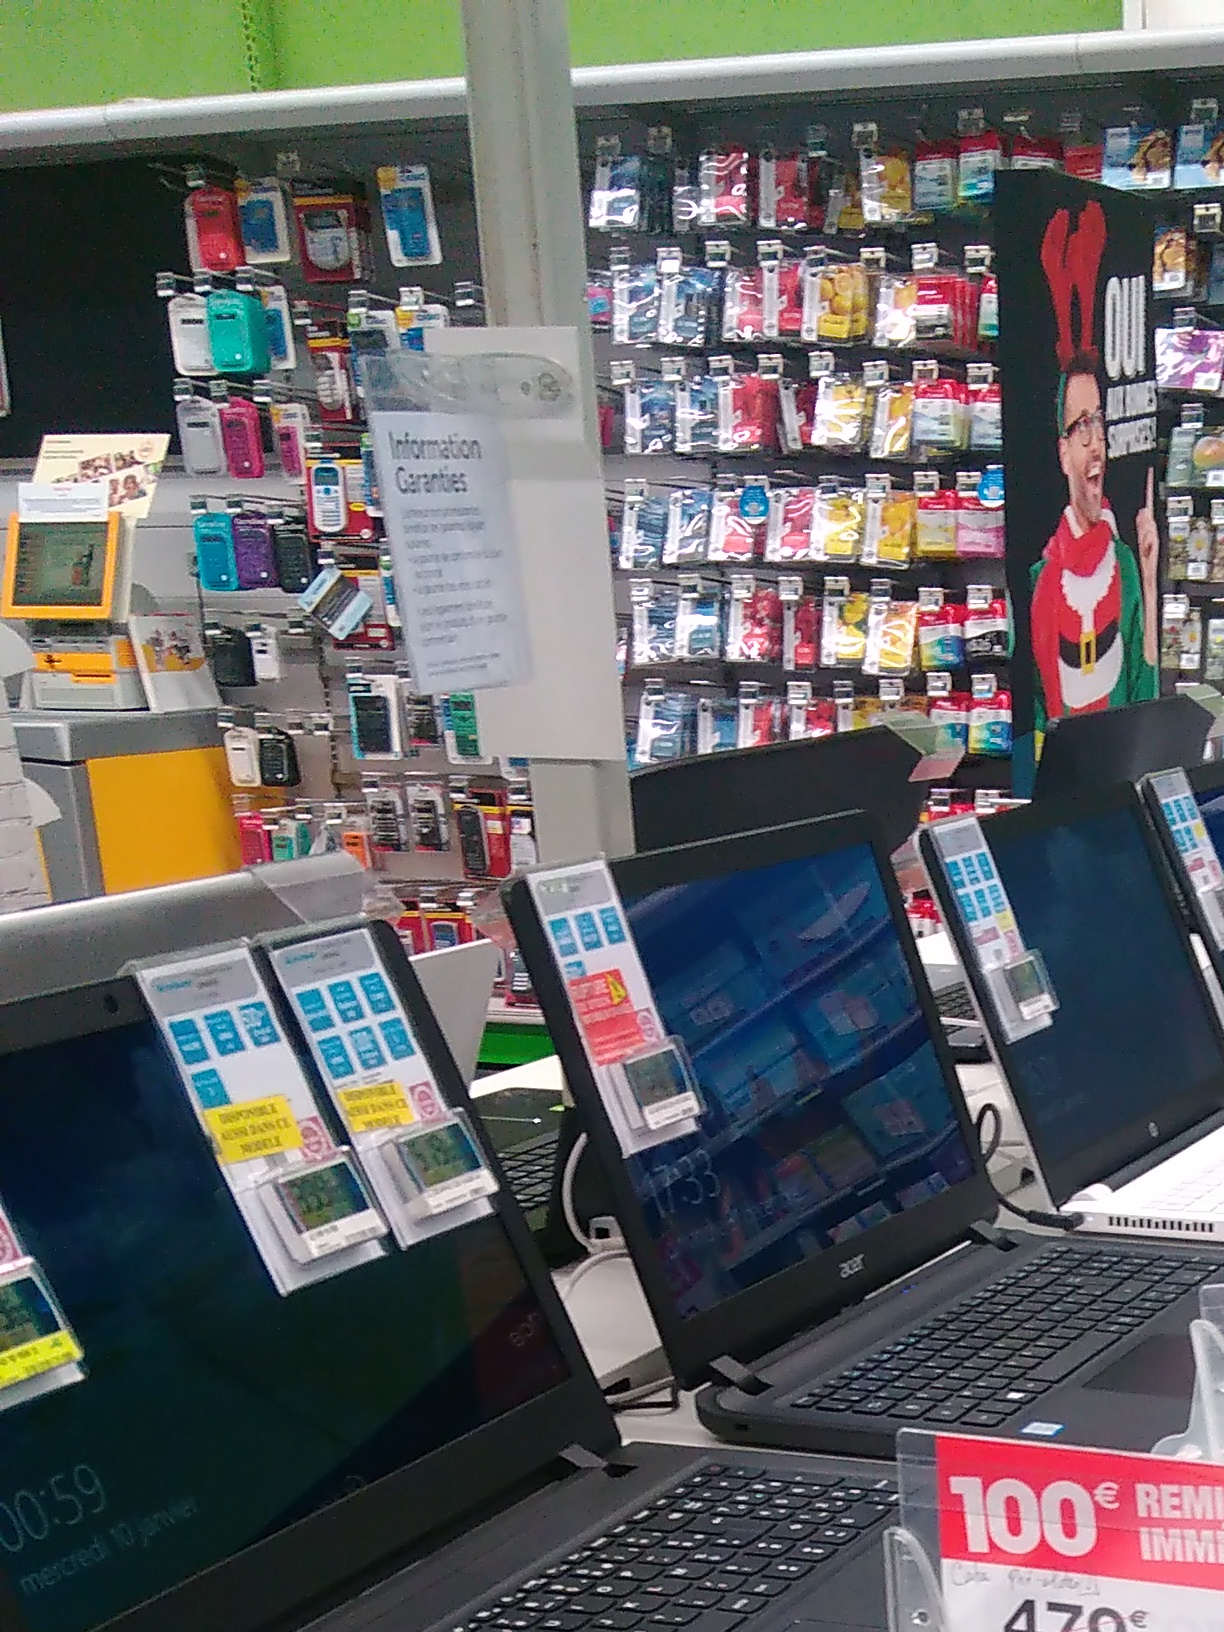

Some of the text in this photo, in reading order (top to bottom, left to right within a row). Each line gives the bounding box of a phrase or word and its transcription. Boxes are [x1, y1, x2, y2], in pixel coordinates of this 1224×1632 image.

[1104, 274, 1146, 381] OUI
[388, 431, 483, 460] Information
[839, 1253, 865, 1279] acer
[949, 1475, 1121, 1558] 100€
